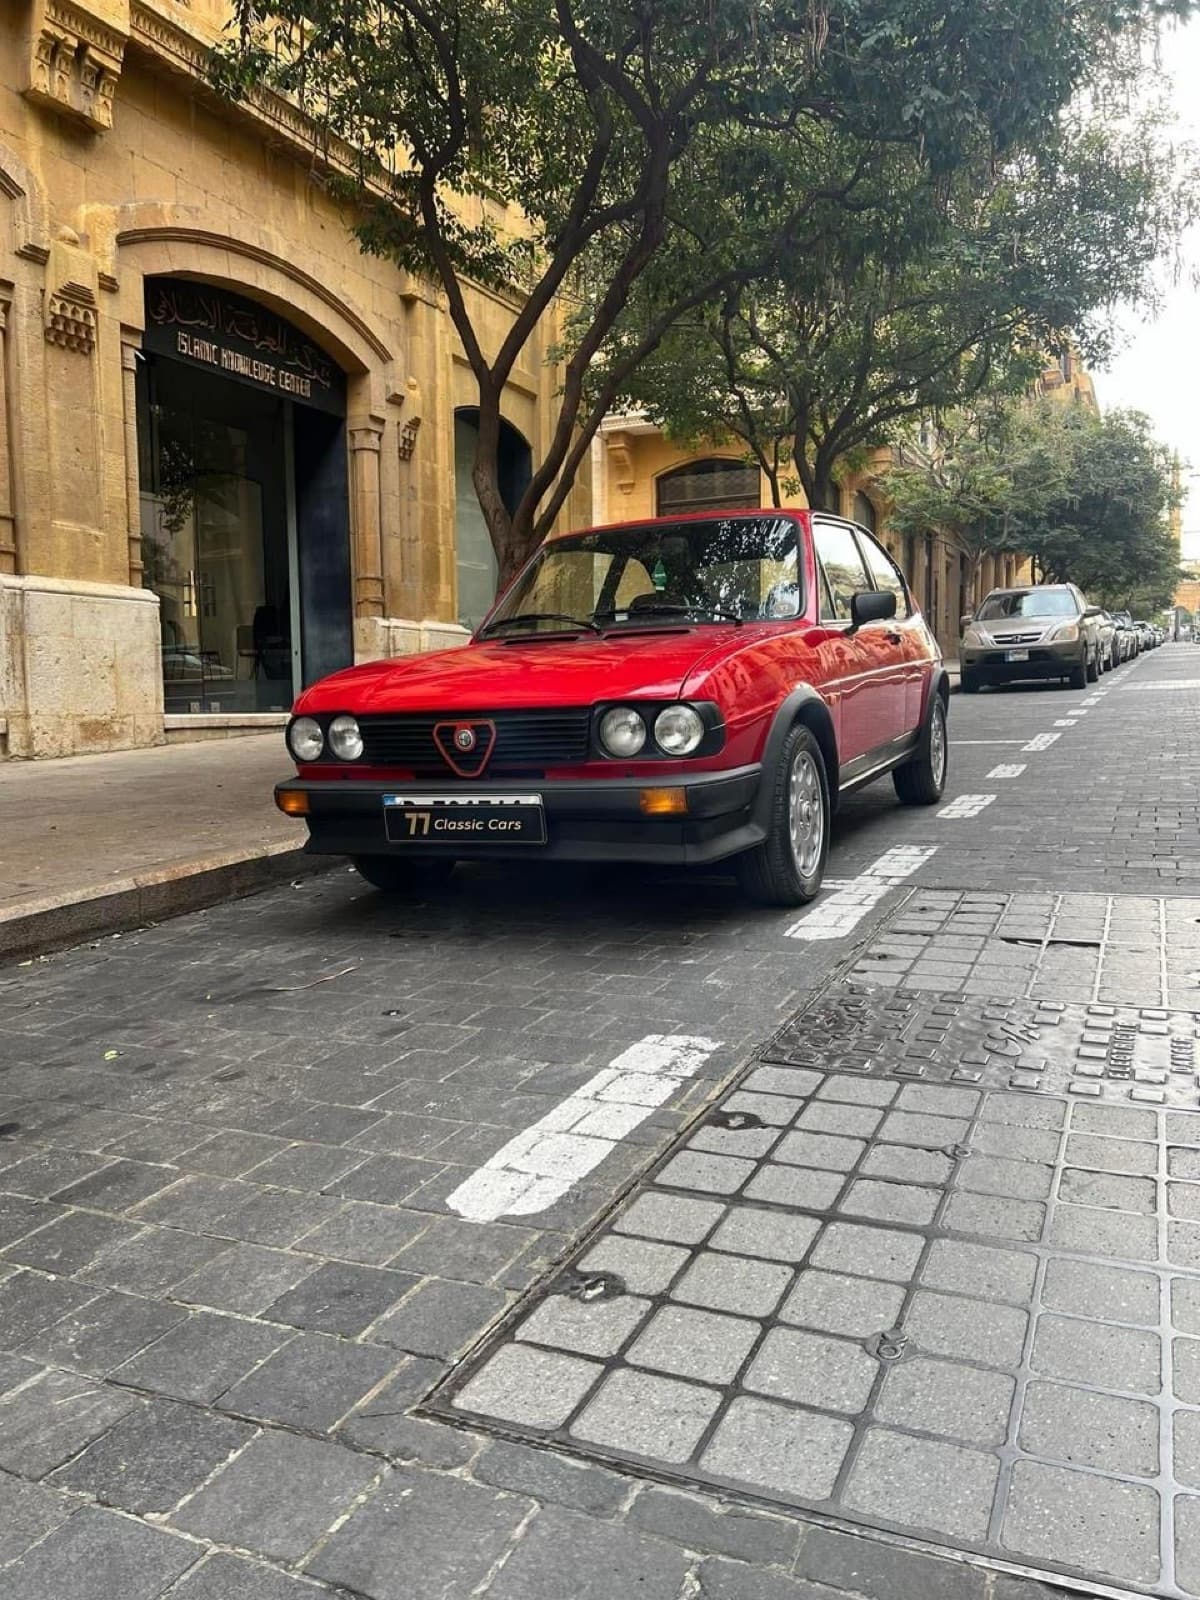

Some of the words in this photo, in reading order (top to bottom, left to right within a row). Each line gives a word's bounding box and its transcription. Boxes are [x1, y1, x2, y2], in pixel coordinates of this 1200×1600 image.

[177, 331, 218, 365] ISLAMIC
[221, 348, 276, 386] KNOWLEDGE
[279, 370, 311, 398] CENTER
[404, 812, 431, 835] 77
[434, 818, 484, 831] Classic
[488, 818, 522, 831] Cars
